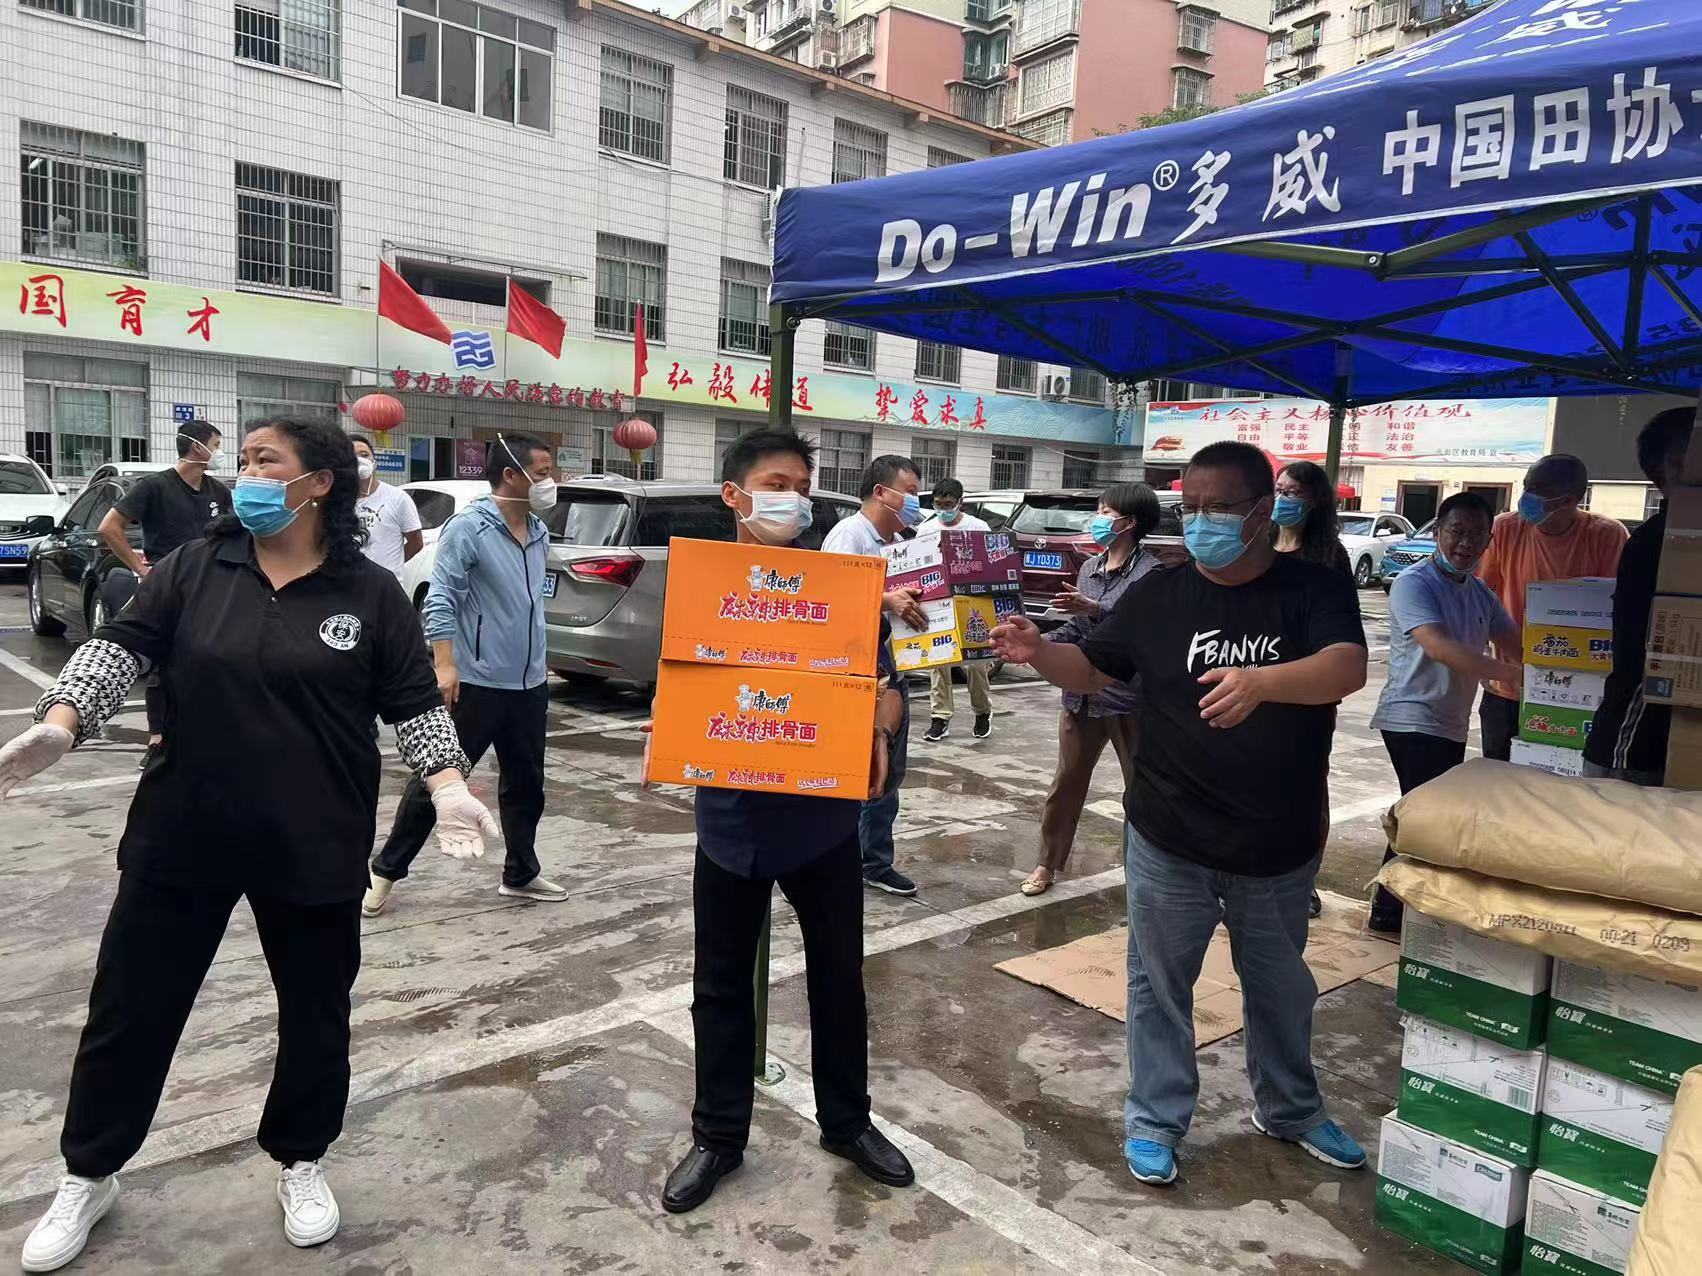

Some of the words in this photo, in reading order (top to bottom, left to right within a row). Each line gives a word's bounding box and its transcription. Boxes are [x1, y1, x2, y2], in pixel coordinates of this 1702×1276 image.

[1382, 66, 1702, 196] 中国田协
[875, 382, 988, 432] 挚爱求真
[1199, 403, 1472, 421] 社会主义核心价值观
[1237, 423, 1261, 432] 富强
[1283, 423, 1310, 432] 民主
[1387, 421, 1416, 431] 和谐
[1237, 433, 1261, 442] 自由
[1283, 433, 1309, 442] 平等
[1385, 432, 1415, 442] 法治
[1282, 442, 1309, 451] 敬业
[1385, 442, 1414, 452] 友善
[718, 592, 830, 623] 麻辣排骨面
[932, 634, 953, 647] BIG
[1542, 633, 1569, 648] 番茄
[1186, 629, 1282, 674] FBANYIS
[706, 711, 818, 743] 麻辣排骨面
[1653, 934, 1690, 952] 0209
